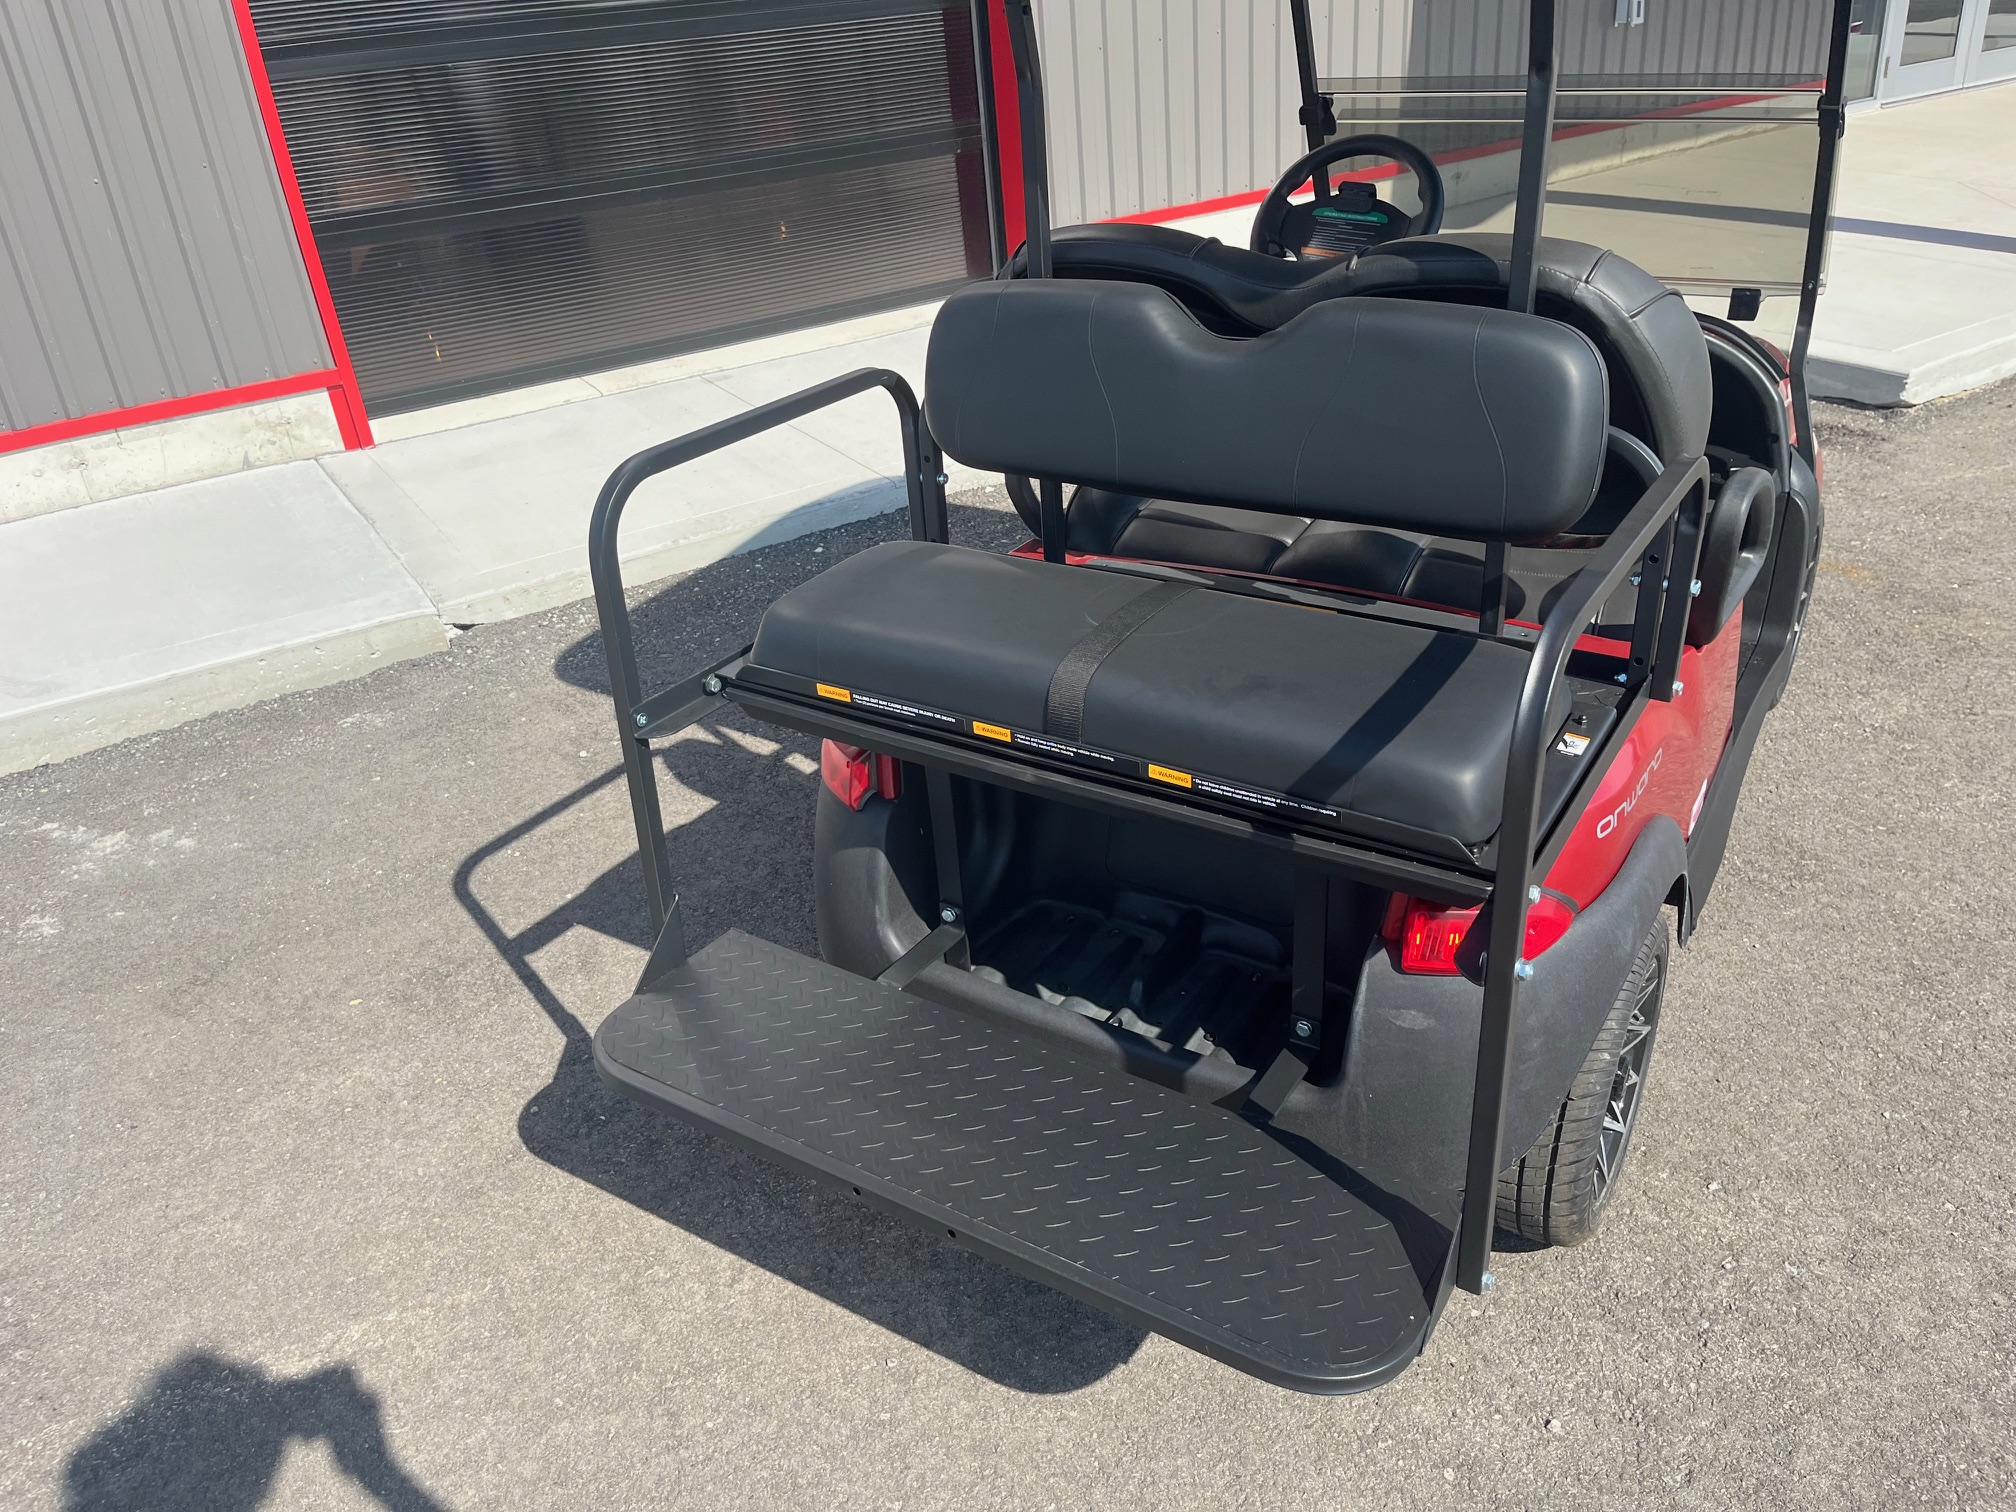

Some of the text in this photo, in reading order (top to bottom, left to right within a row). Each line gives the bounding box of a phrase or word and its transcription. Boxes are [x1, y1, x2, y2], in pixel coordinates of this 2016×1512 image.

[1347, 213, 1378, 221] INSTRUCTIONS
[824, 689, 848, 699] WARNING
[981, 727, 1008, 738] WARNING
[1158, 770, 1189, 784] WARNING
